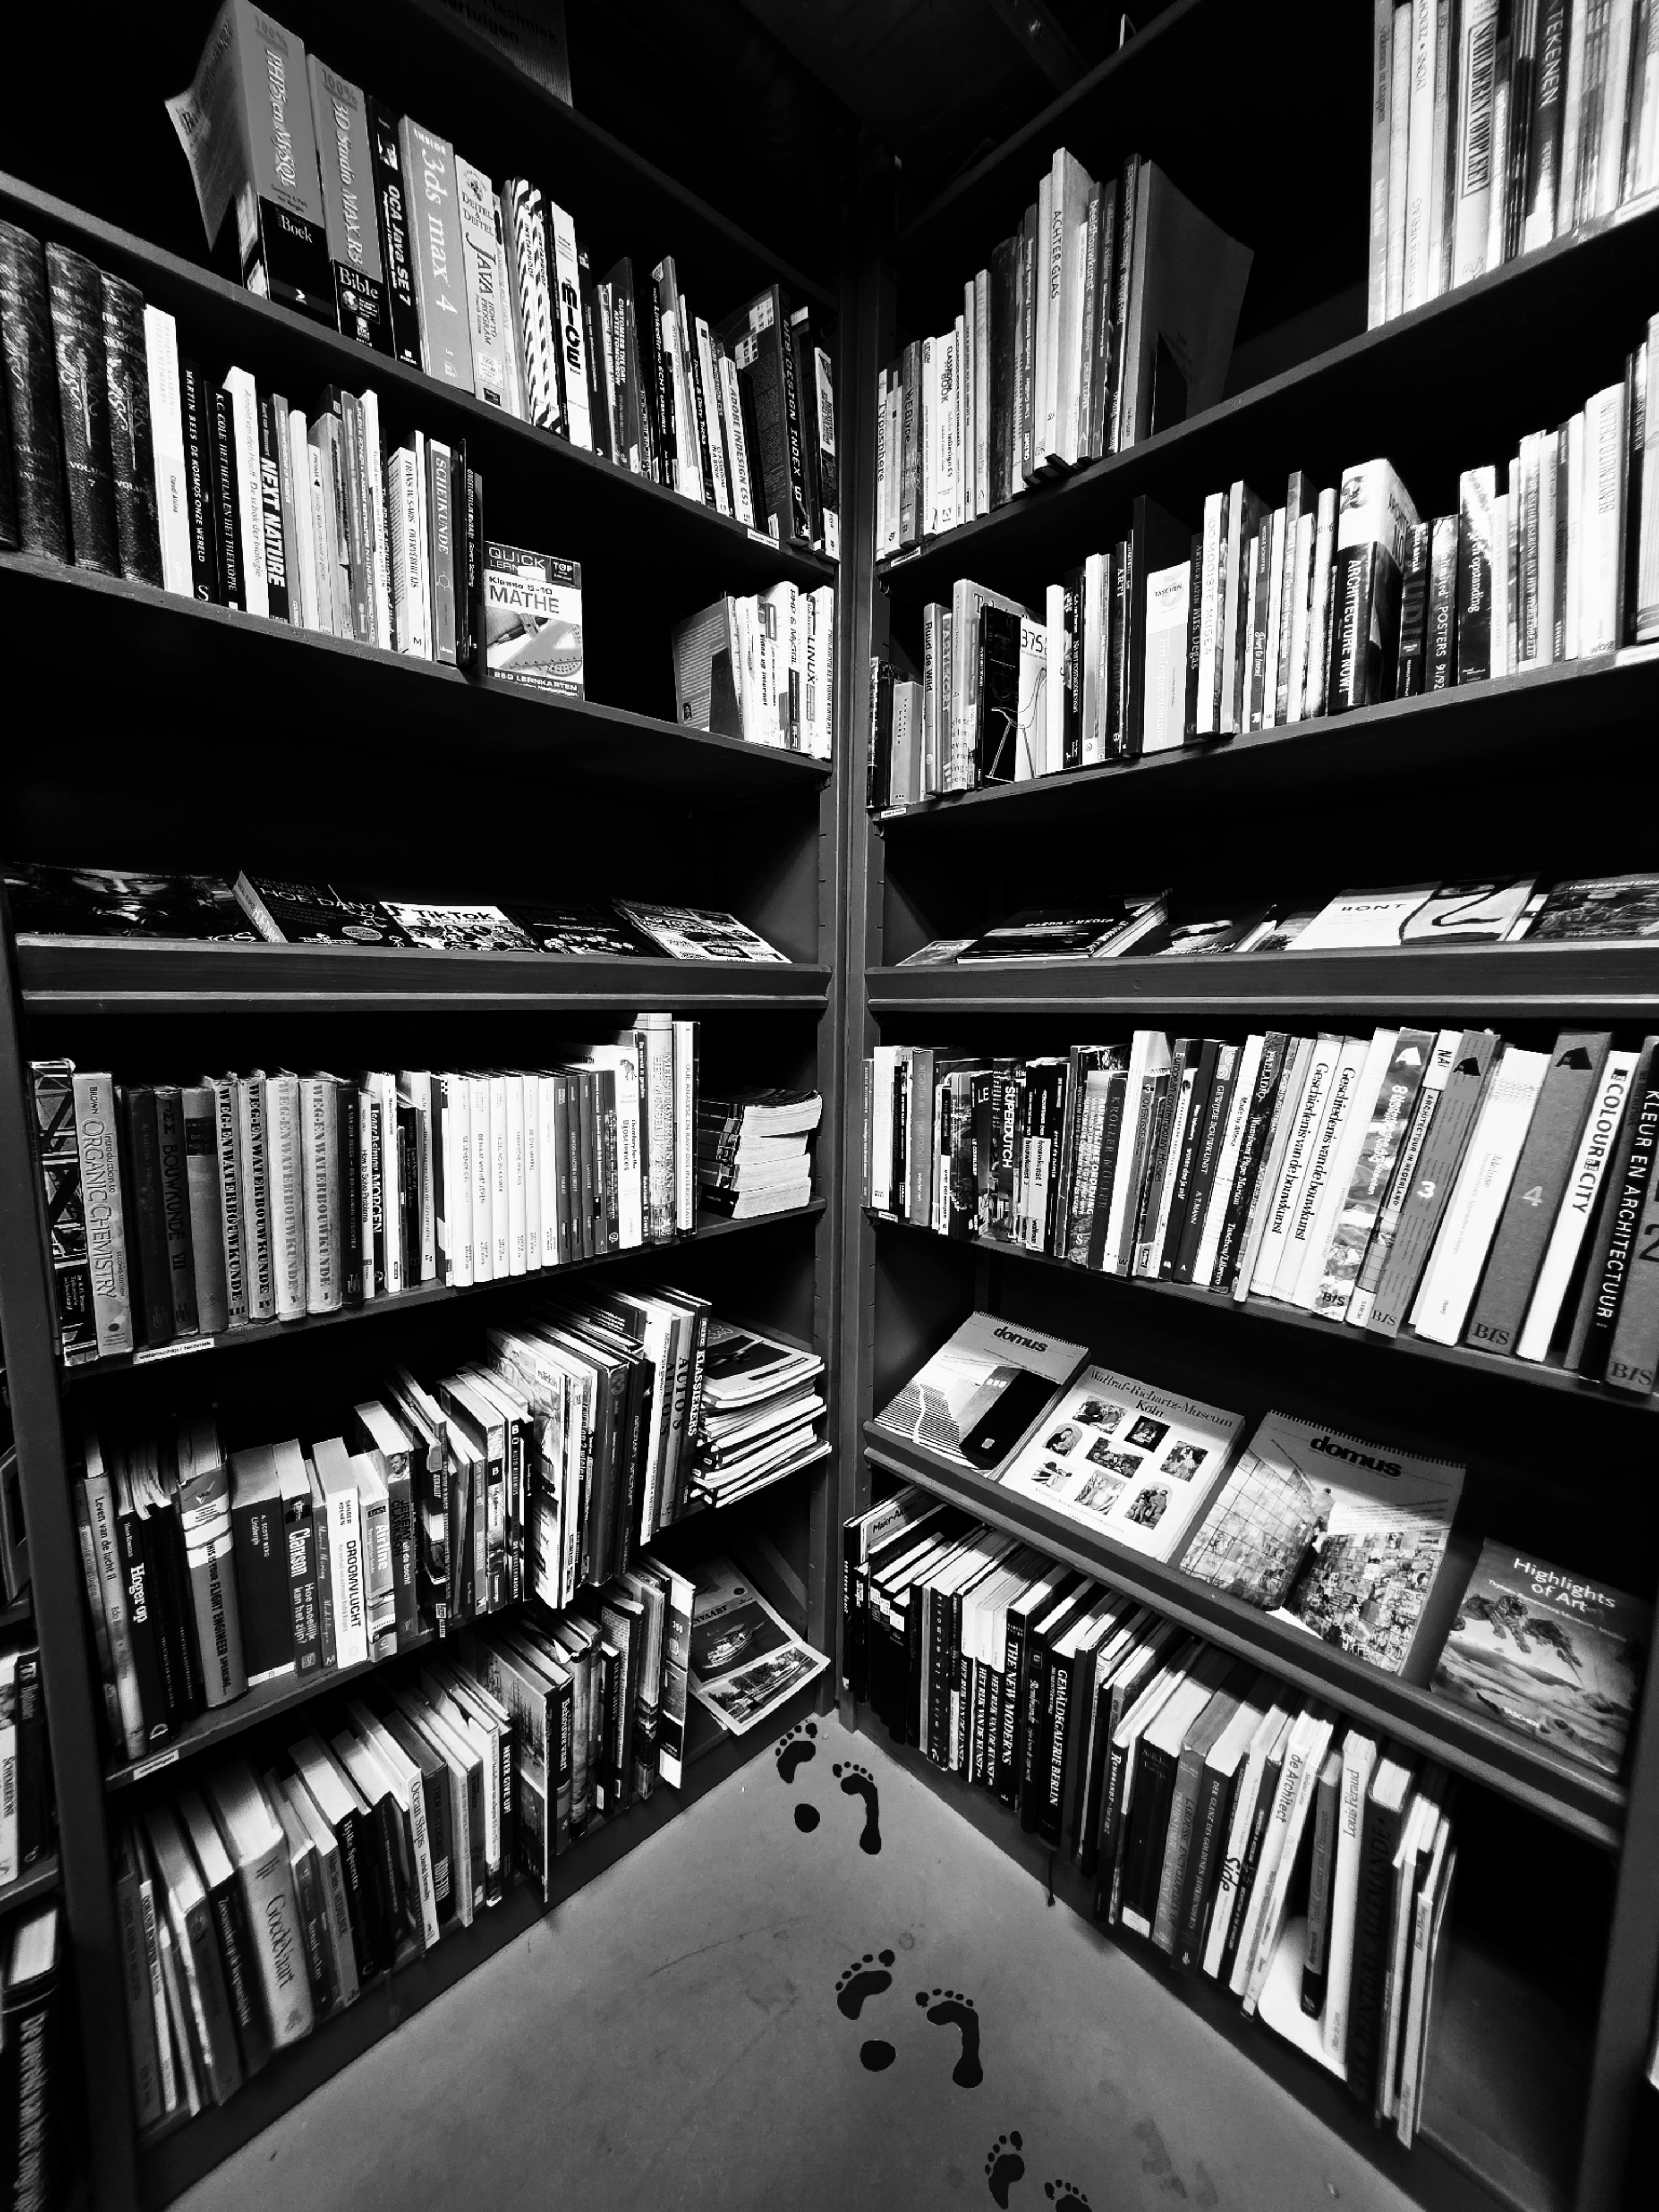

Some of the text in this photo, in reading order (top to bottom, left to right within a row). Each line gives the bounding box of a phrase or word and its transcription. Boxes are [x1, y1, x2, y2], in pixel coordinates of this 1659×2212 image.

[270, 125, 296, 188] MySQL
[336, 131, 354, 185] Studio
[341, 189, 361, 238] MAX
[421, 149, 447, 205] 3ds
[435, 294, 457, 314] 4
[346, 238, 362, 265] R3
[388, 185, 410, 306] OCA Java SE 7
[1051, 210, 1061, 299] ACHTER GLAS
[338, 267, 378, 299] Bible
[481, 298, 490, 345] PROGRAM
[490, 324, 496, 337] TO
[217, 413, 226, 441] COLE
[729, 388, 739, 429] ADOBE
[734, 430, 744, 485] INDESIGN
[185, 370, 205, 562] MARTIN REES DE KOSMOS ONZE WERELD
[218, 444, 228, 464] HET
[404, 460, 414, 487] FRANS
[220, 465, 230, 501] HEELAL
[249, 482, 258, 495] De
[259, 457, 279, 510] NEXT
[435, 458, 448, 555] SCHEIKUNDE
[223, 503, 232, 517] EN
[223, 518, 233, 538] HET
[250, 497, 260, 522] schok
[250, 541, 262, 577] biologie
[262, 512, 284, 587] NATURE
[488, 547, 544, 570] QUICK
[1204, 542, 1215, 602] MOOISTE
[489, 585, 559, 614] MATHE
[1467, 557, 1484, 613] opstanding
[1203, 609, 1213, 656] MUSEA
[1338, 560, 1361, 694] ARCHITECTURE NOW!
[1435, 606, 1448, 658] POSTERS
[925, 654, 932, 666] de
[1155, 661, 1168, 743] Impressionisme
[260, 888, 312, 905] HOE
[411, 909, 495, 920] TikTok
[1168, 1051, 1184, 1092] European
[88, 1087, 98, 1114] BROWN
[1159, 1094, 1177, 1151] contemporary
[1588, 1084, 1623, 1159] COLOUR
[1634, 1090, 1658, 1147] KLEUR
[1001, 1086, 1015, 1168] SUPERDUTCH
[1200, 1121, 1217, 1173] BOUWKUNST
[1271, 1062, 1328, 1234] Geschiedenis van de bouwkunst
[1391, 1094, 1433, 1207] ARCHITECTUUR IN NEDERLAND
[1154, 1154, 1168, 1182] Houses
[1294, 1067, 1357, 1242] Geschiedenis van de bouwkunst
[1627, 1155, 1647, 1178] EN
[81, 1120, 116, 1299] ORGANIC CHEMISTRY
[163, 1144, 183, 1240] BOUWKUNDE
[1572, 1172, 1595, 1214] CITY
[1595, 1185, 1638, 1317] ARCHITECTUUR
[994, 1326, 1047, 1353] domus
[1472, 1323, 1509, 1345] BIS
[687, 1350, 704, 1436] KLASSIEKERS
[1090, 1370, 1233, 1427] Wallraf-Richartz-Museum
[1310, 1436, 1402, 1479] domus
[94, 1496, 106, 1522] Leven
[98, 1524, 108, 1538] van
[251, 1517, 259, 1545] Lindbergh
[391, 1500, 401, 1557] CLARKSON
[400, 1500, 410, 1541] JEREMY
[101, 1540, 109, 1551] de
[102, 1552, 112, 1573] lucht
[288, 1528, 310, 1577] Clarkson
[375, 1525, 390, 1570] Airline
[129, 1563, 147, 1622] Hoger op
[346, 1540, 360, 1627] DROOMVLUCHT
[1512, 1557, 1617, 1610] Highlights
[1530, 1582, 1588, 1613] of Art
[293, 1587, 307, 1644] kan het zijn?
[304, 1583, 317, 1640] Hoe moeilijk
[1001, 1642, 1018, 1765] THE NEW MODERNS
[1051, 1670, 1067, 1768] GEMÄLDEGALERIE
[411, 1782, 423, 1817] Ocean
[1048, 1769, 1060, 1806] BERLIN
[1275, 1754, 1301, 1823] de Architect
[1343, 1767, 1360, 1837] Louis Féraud
[413, 1818, 425, 1849] Ships
